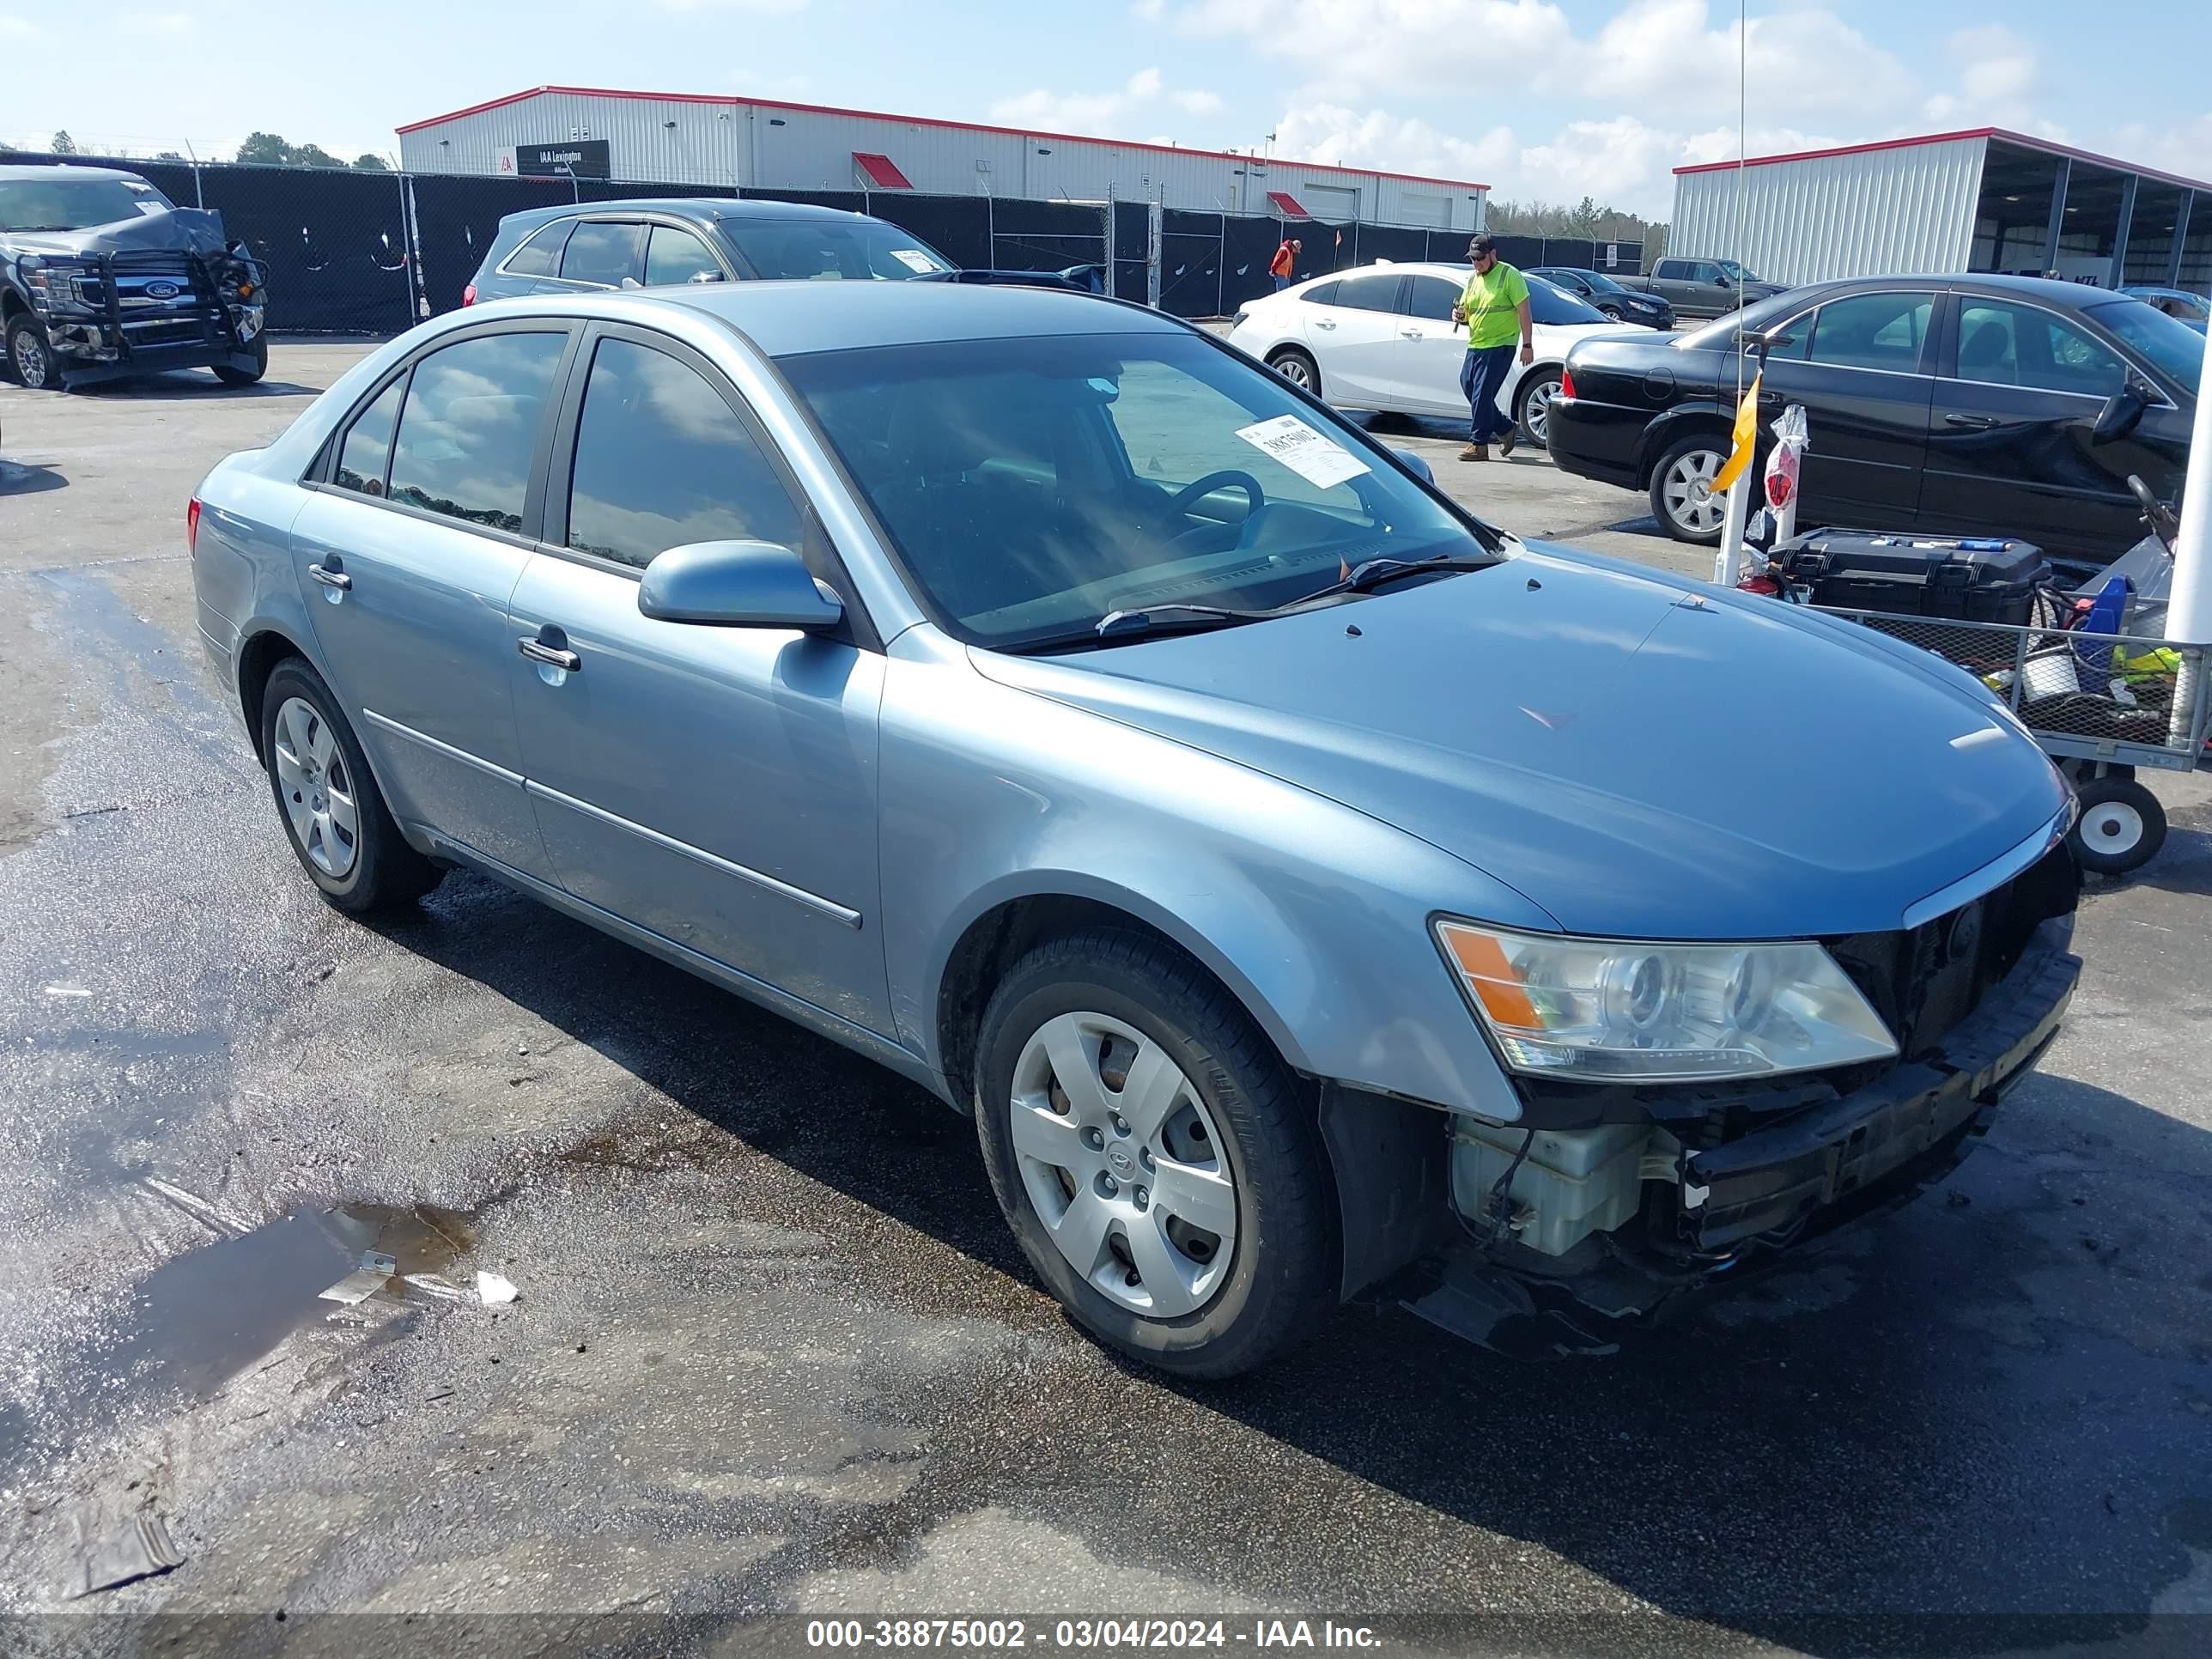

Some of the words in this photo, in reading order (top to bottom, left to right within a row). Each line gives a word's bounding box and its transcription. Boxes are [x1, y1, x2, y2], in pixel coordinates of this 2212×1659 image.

[540, 151, 551, 163] IAA
[552, 149, 582, 164] Lexington
[1263, 429, 1317, 453] 38875002
